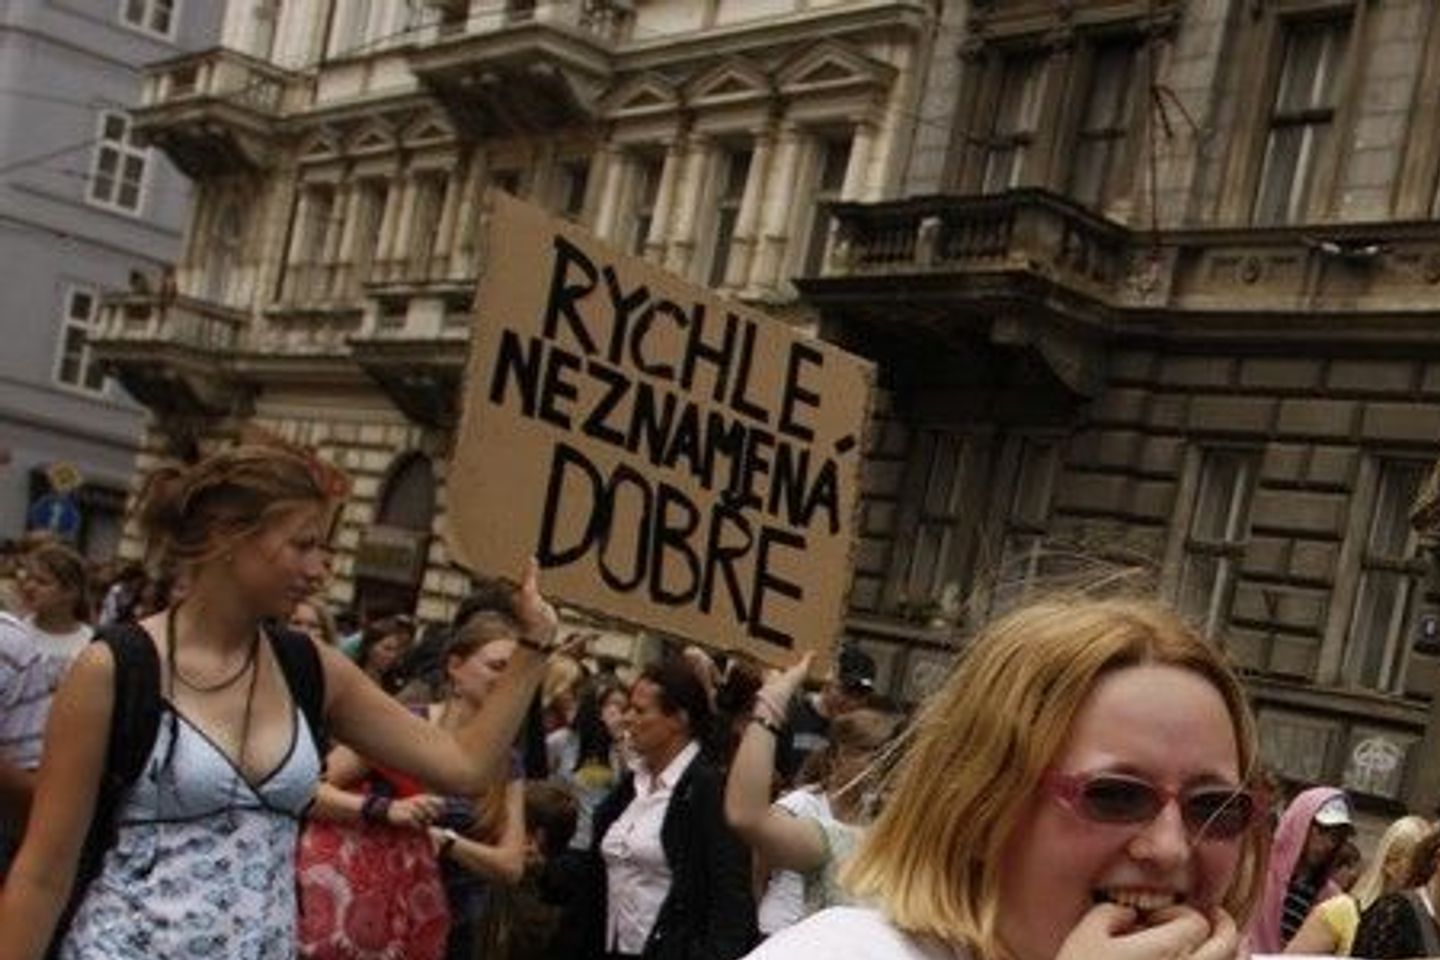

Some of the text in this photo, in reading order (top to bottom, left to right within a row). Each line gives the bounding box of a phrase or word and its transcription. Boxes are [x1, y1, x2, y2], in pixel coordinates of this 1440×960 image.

[489, 329, 855, 535] NEZNAMENÁ
[544, 235, 824, 443] RYCHLE
[537, 442, 807, 650] DOBŘE
